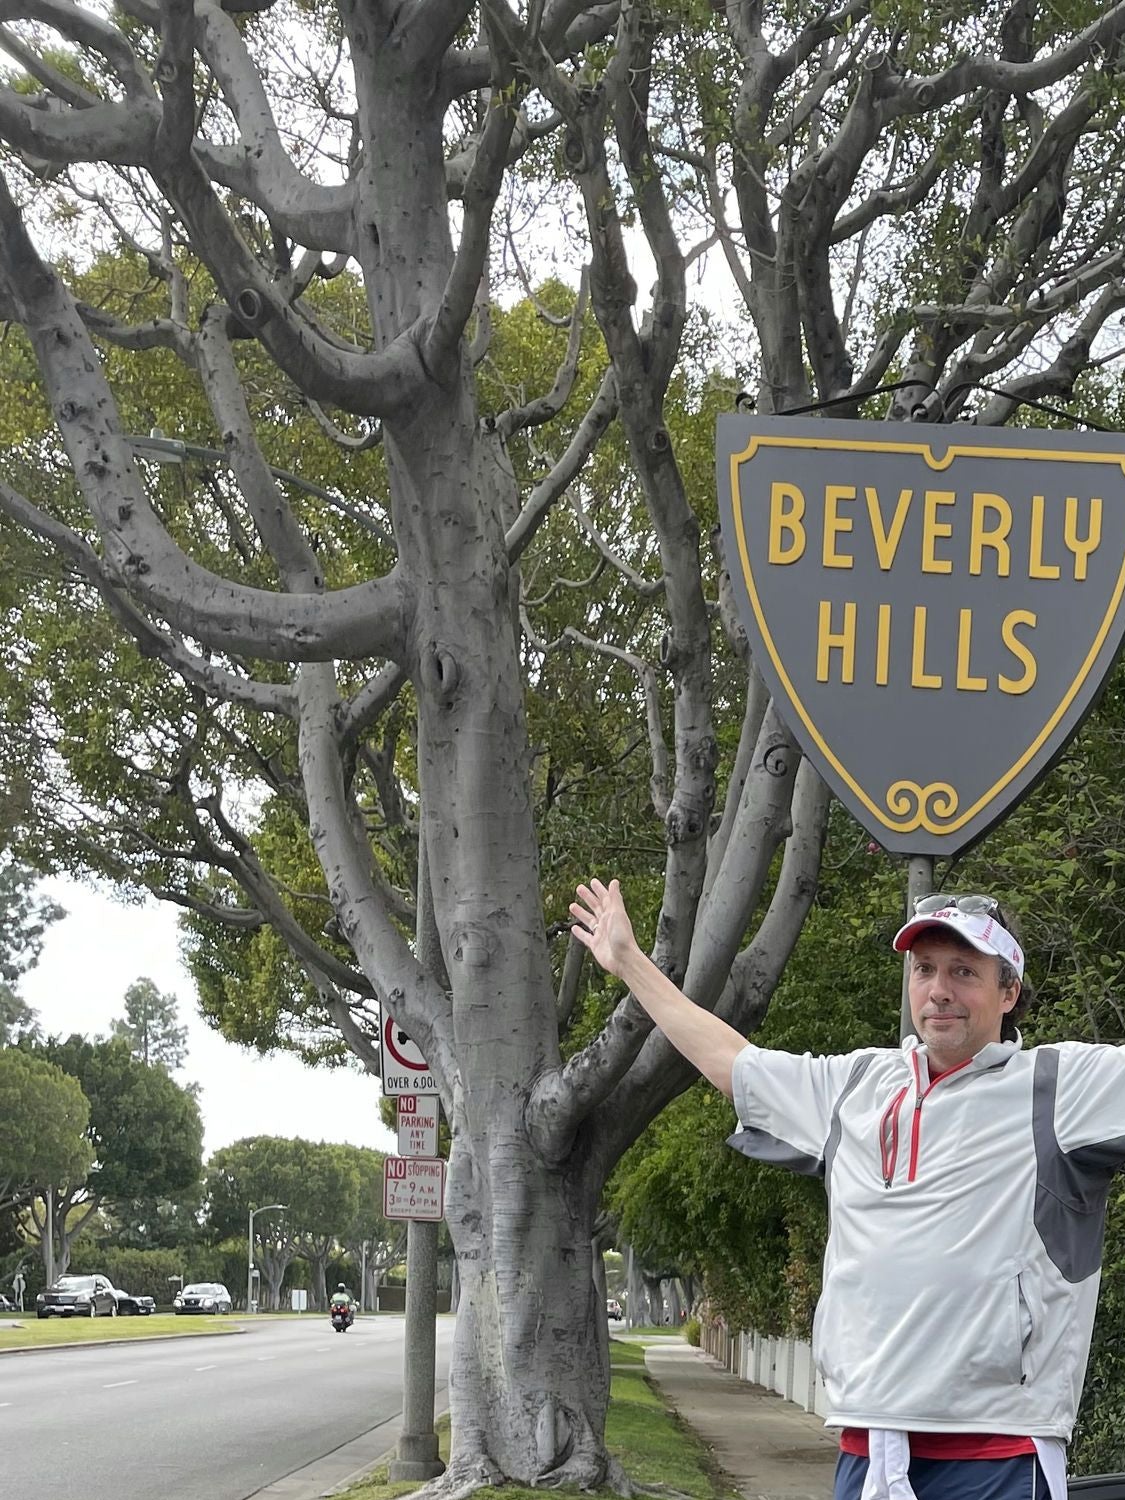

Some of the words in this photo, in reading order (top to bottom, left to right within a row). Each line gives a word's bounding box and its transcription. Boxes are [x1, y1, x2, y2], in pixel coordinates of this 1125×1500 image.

[768, 482, 1103, 581] BEVERLY
[816, 600, 1038, 695] HILLS
[387, 1076, 409, 1089] OVER
[400, 1096, 414, 1111] NO
[400, 1115, 435, 1128] PARKING
[410, 1129, 425, 1139] ANY
[409, 1140, 425, 1150] TIME
[387, 1160, 405, 1178] NO
[407, 1162, 440, 1177] STOPPING
